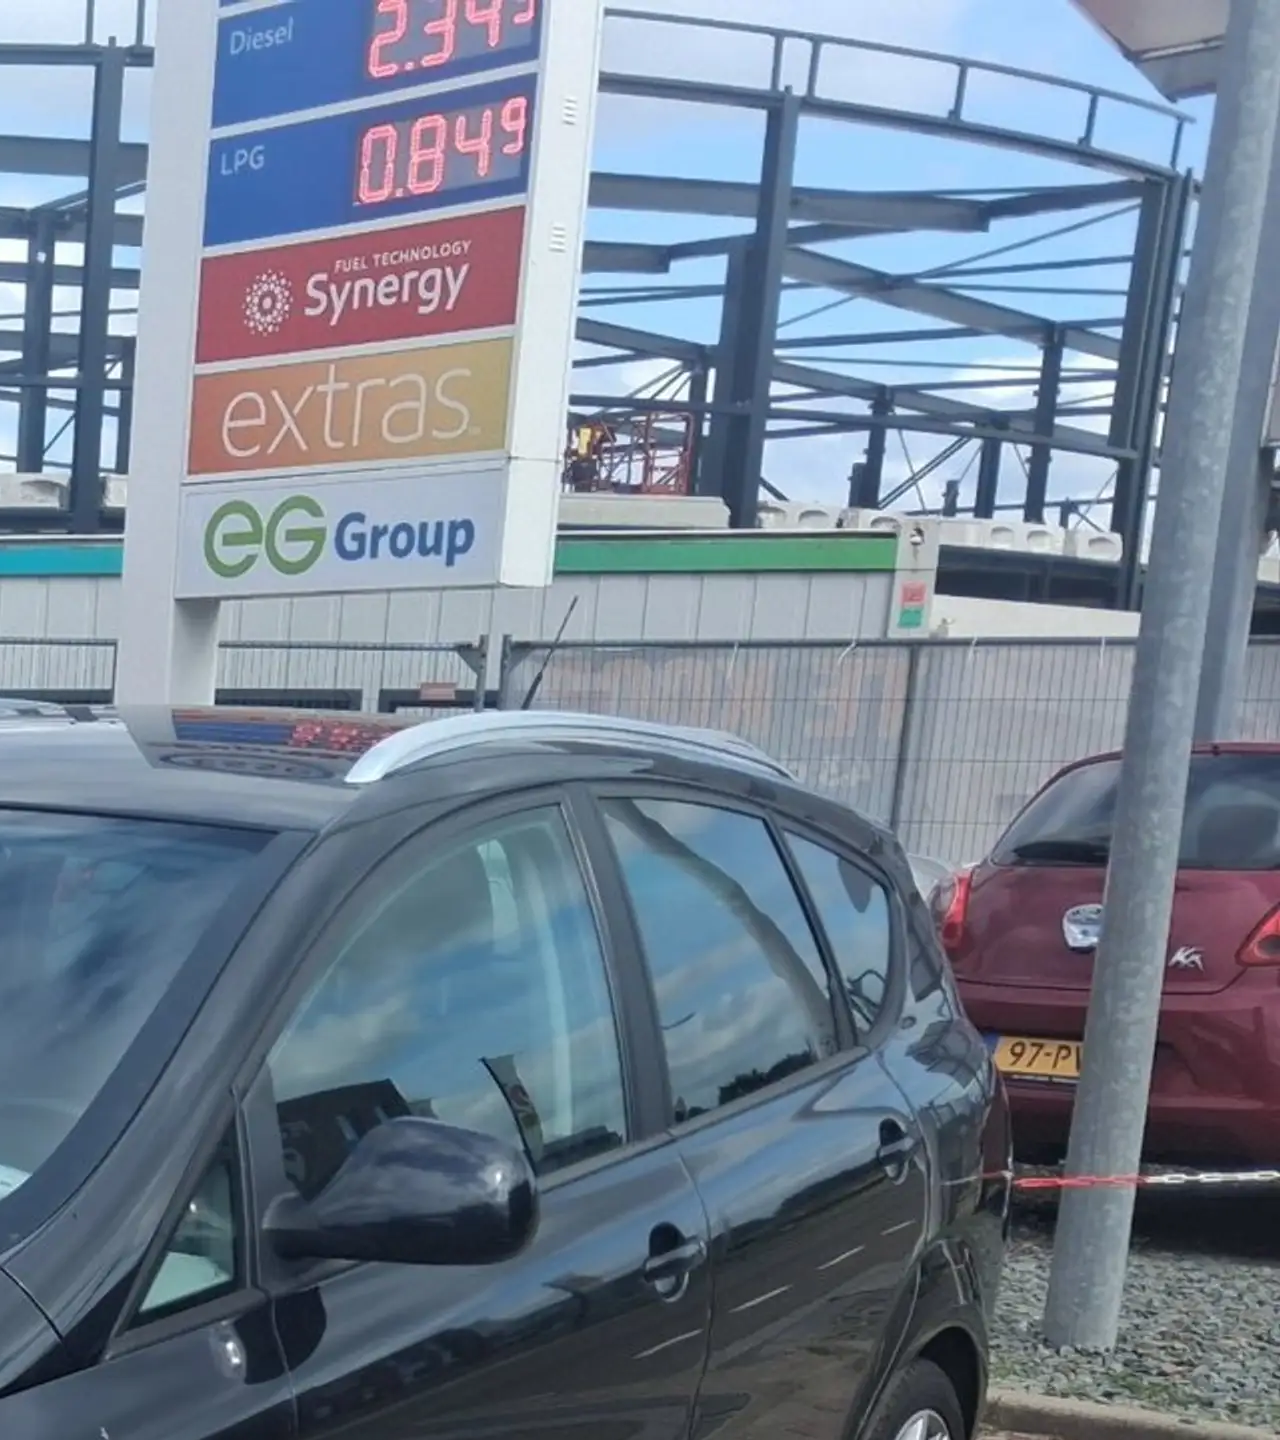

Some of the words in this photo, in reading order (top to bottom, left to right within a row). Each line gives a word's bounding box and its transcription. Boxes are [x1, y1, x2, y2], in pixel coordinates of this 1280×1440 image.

[229, 17, 294, 56] Diesel
[220, 145, 265, 176] LPG
[358, 96, 527, 203] 0.849
[334, 256, 369, 275] FUEL
[373, 240, 473, 268] TECHNOLOGY
[303, 262, 471, 327] Synergy
[221, 363, 472, 458] extras
[334, 511, 476, 568] Group
[1009, 1041, 1082, 1071] 97-P
